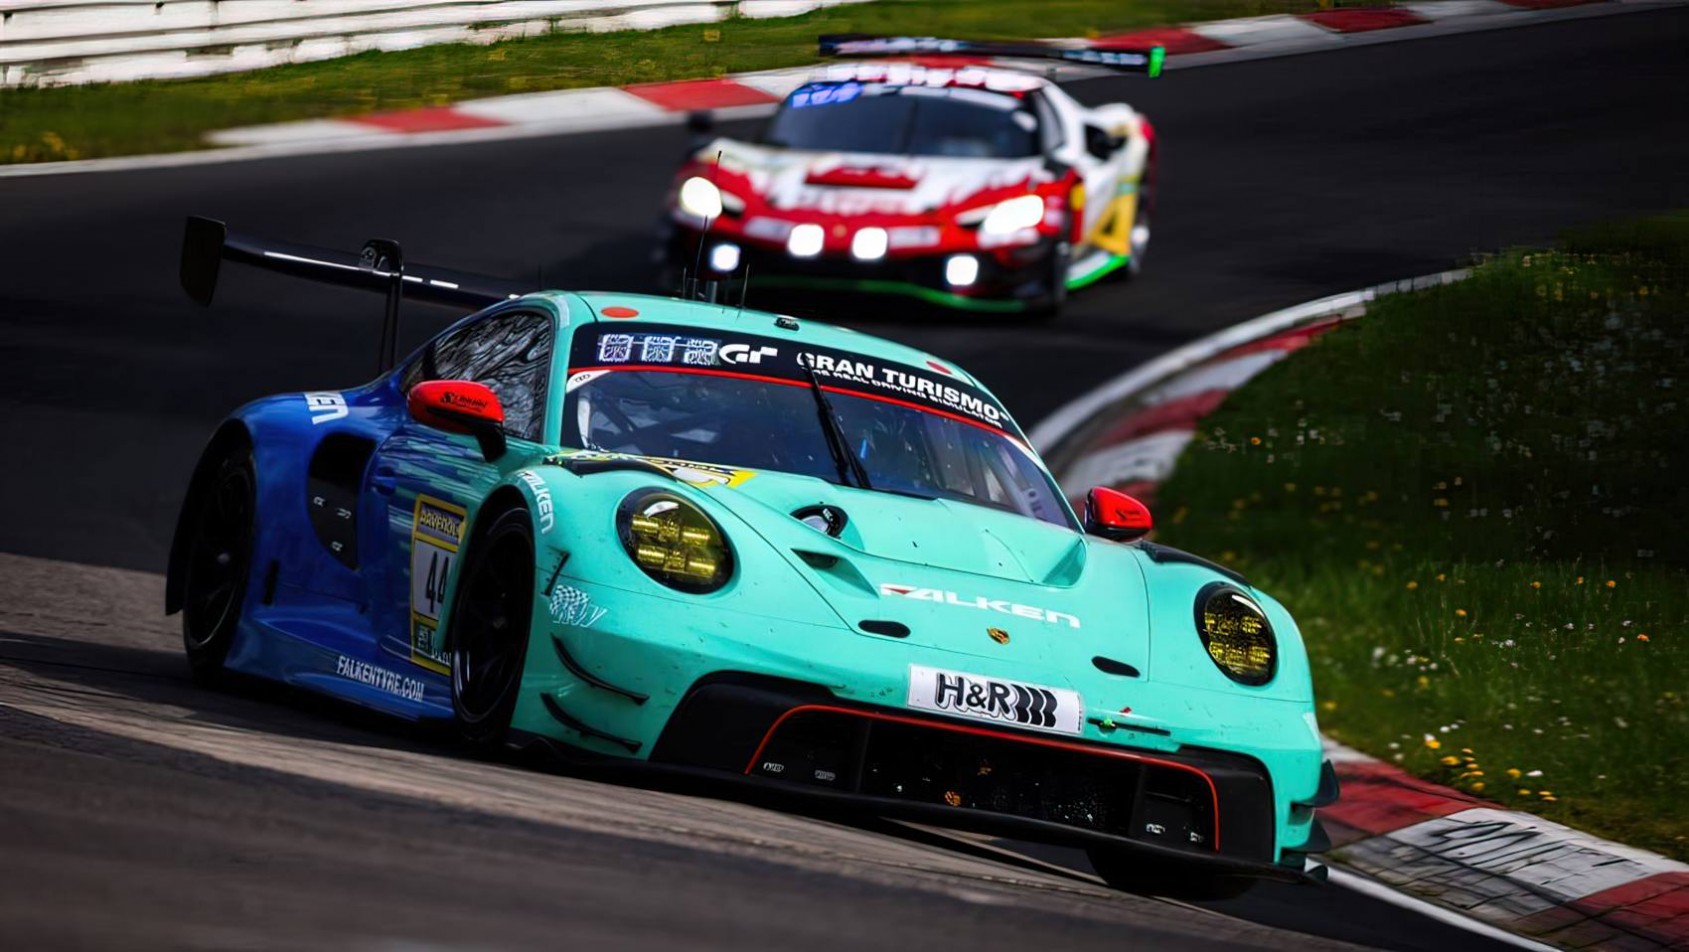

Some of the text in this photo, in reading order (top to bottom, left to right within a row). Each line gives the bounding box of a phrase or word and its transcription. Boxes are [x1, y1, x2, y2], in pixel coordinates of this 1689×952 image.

[796, 352, 1001, 420] GRAN TURISMO
[879, 583, 1081, 629] FALKEN
[336, 655, 425, 702] FALKENTYRE.COM
[936, 673, 1015, 719] H&R
